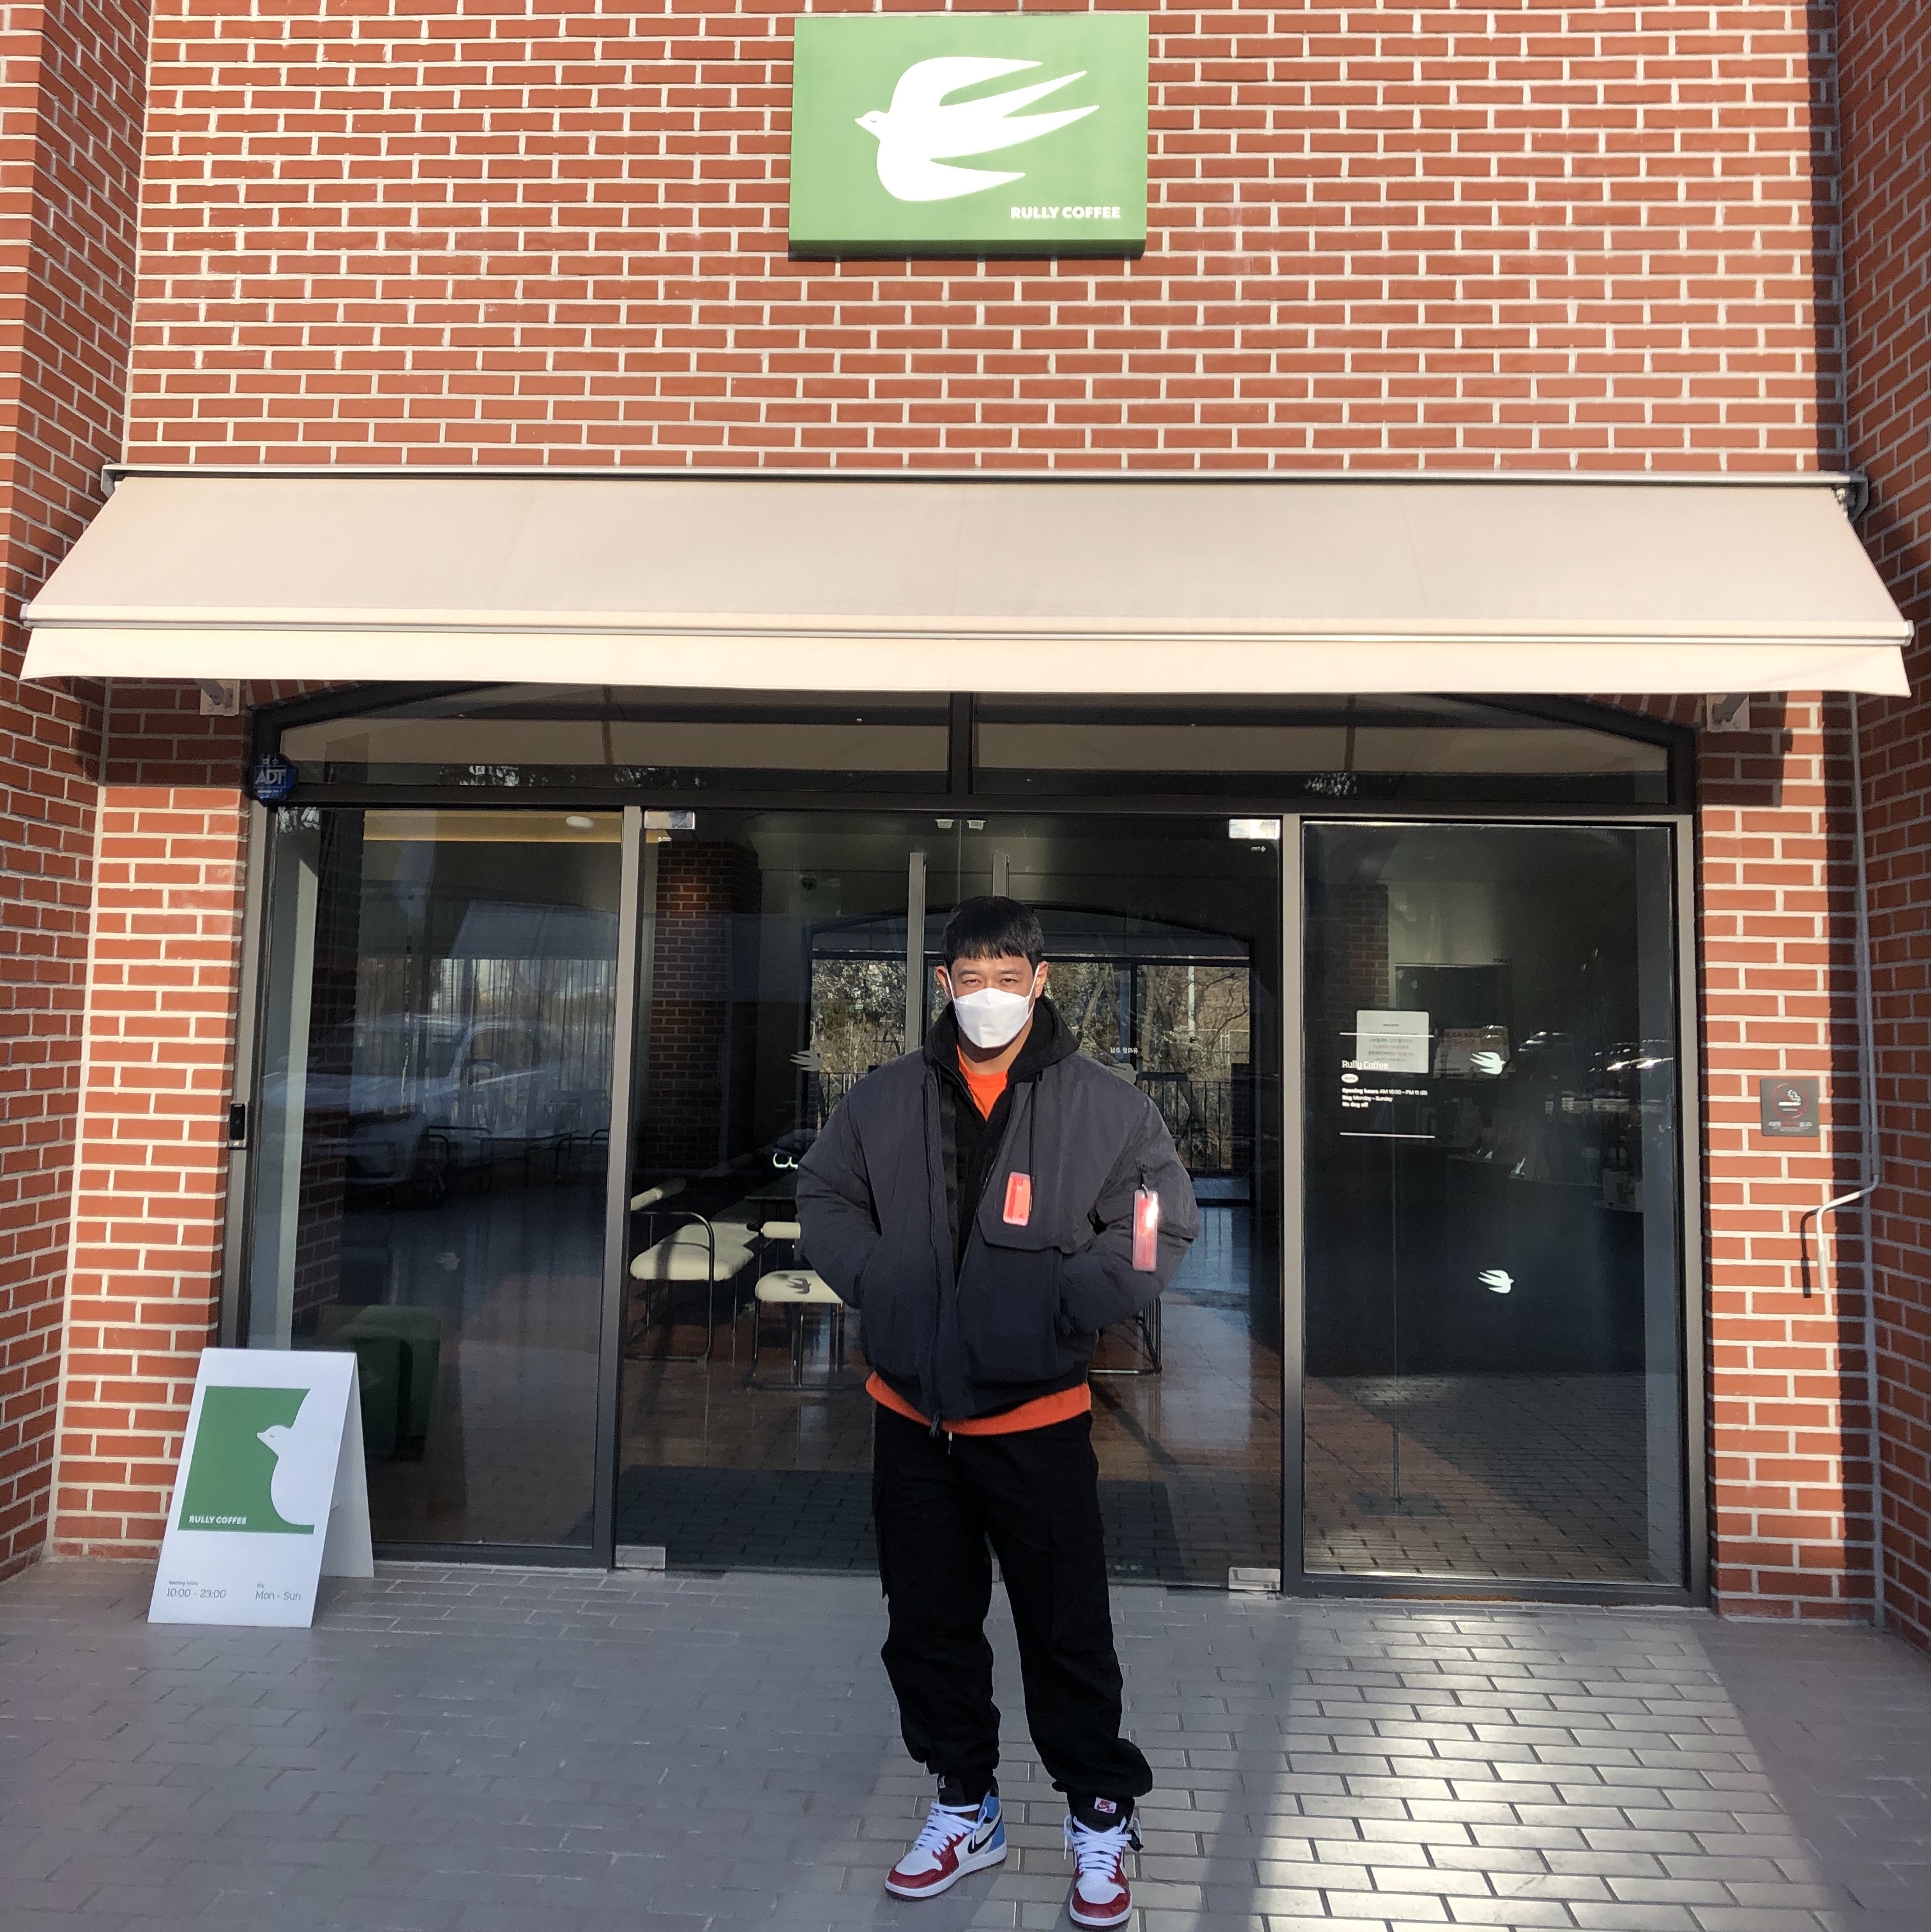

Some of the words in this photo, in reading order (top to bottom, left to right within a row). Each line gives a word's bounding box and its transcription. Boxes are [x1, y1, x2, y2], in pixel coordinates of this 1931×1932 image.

[1010, 206, 1060, 219] RULLY
[1061, 206, 1121, 219] COFFEE
[254, 768, 287, 785] ADT
[1342, 1060, 1362, 1070] Rully
[1363, 1061, 1389, 1069] Coffee
[216, 1516, 247, 1525] COFFEE
[167, 1588, 191, 1597] 10:00
[199, 1589, 226, 1599] 23:00
[255, 1591, 275, 1600] Mon
[283, 1592, 301, 1601] Sun
